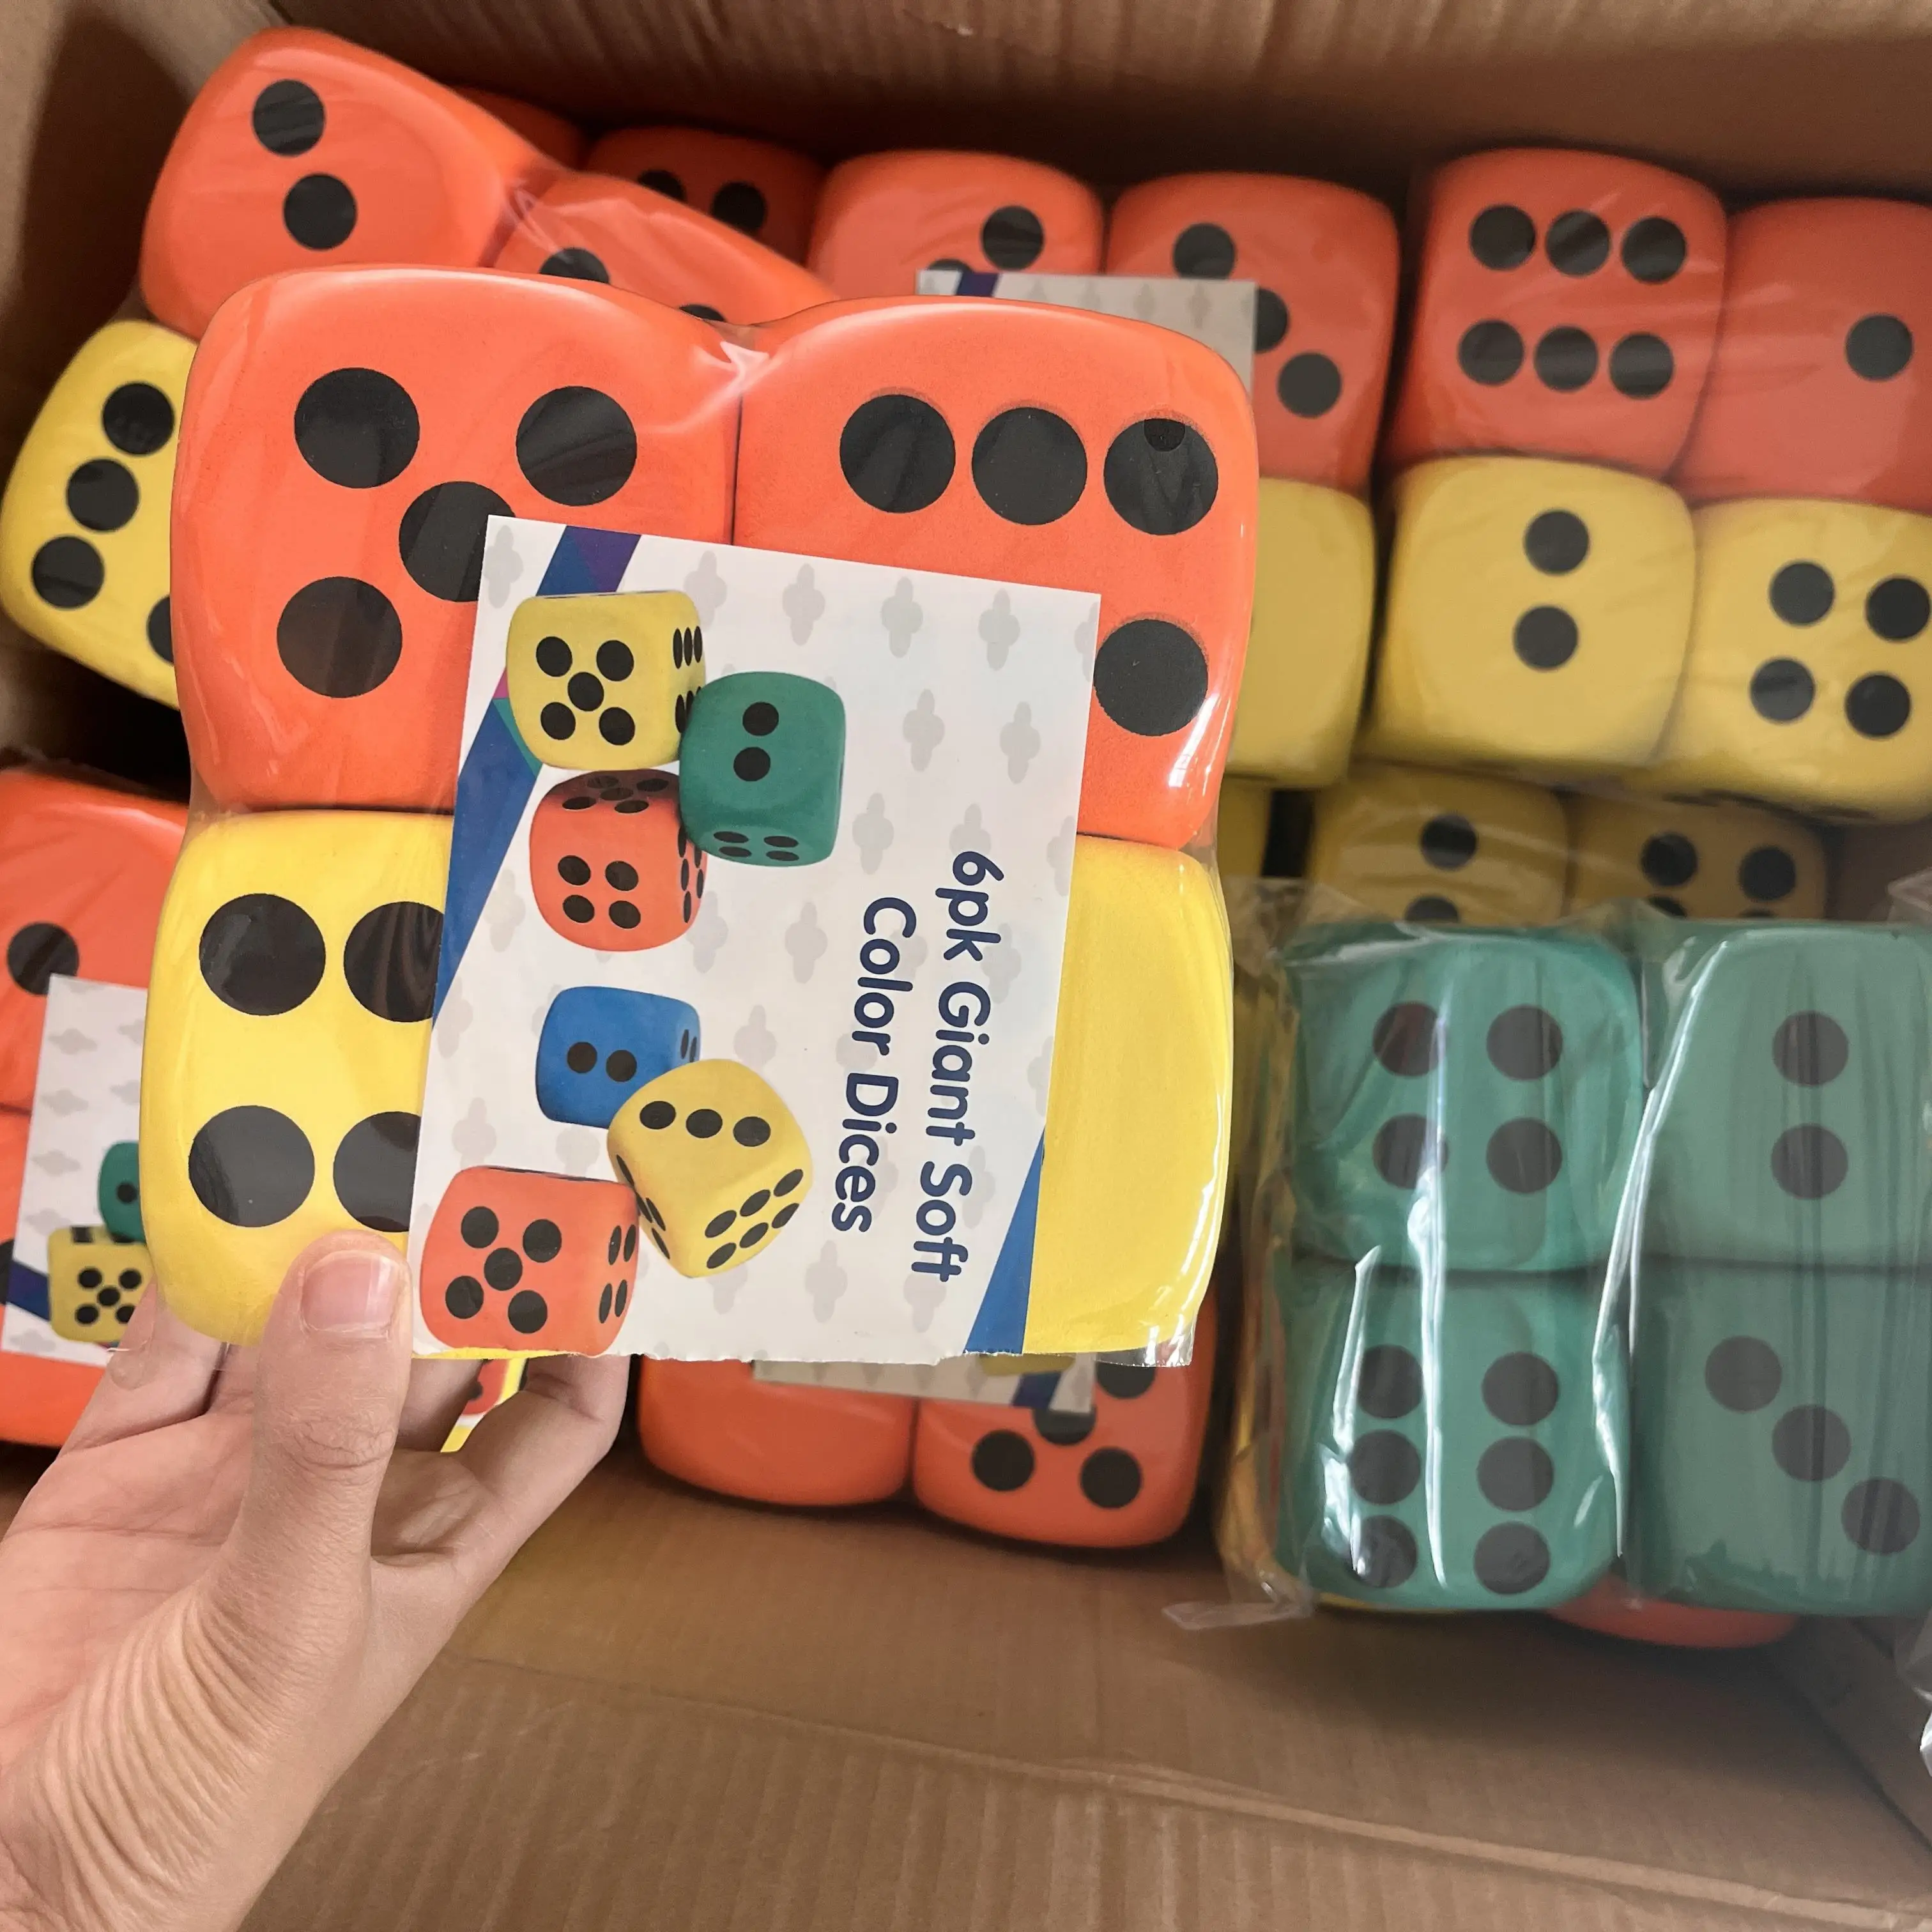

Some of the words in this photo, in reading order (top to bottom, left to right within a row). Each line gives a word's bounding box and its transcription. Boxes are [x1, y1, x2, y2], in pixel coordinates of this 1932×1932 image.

[851, 897, 917, 1056] Color
[935, 851, 1004, 962] 6pk
[926, 981, 991, 1146] Giant
[831, 1073, 899, 1232] Dices
[911, 1161, 972, 1282] Soft
